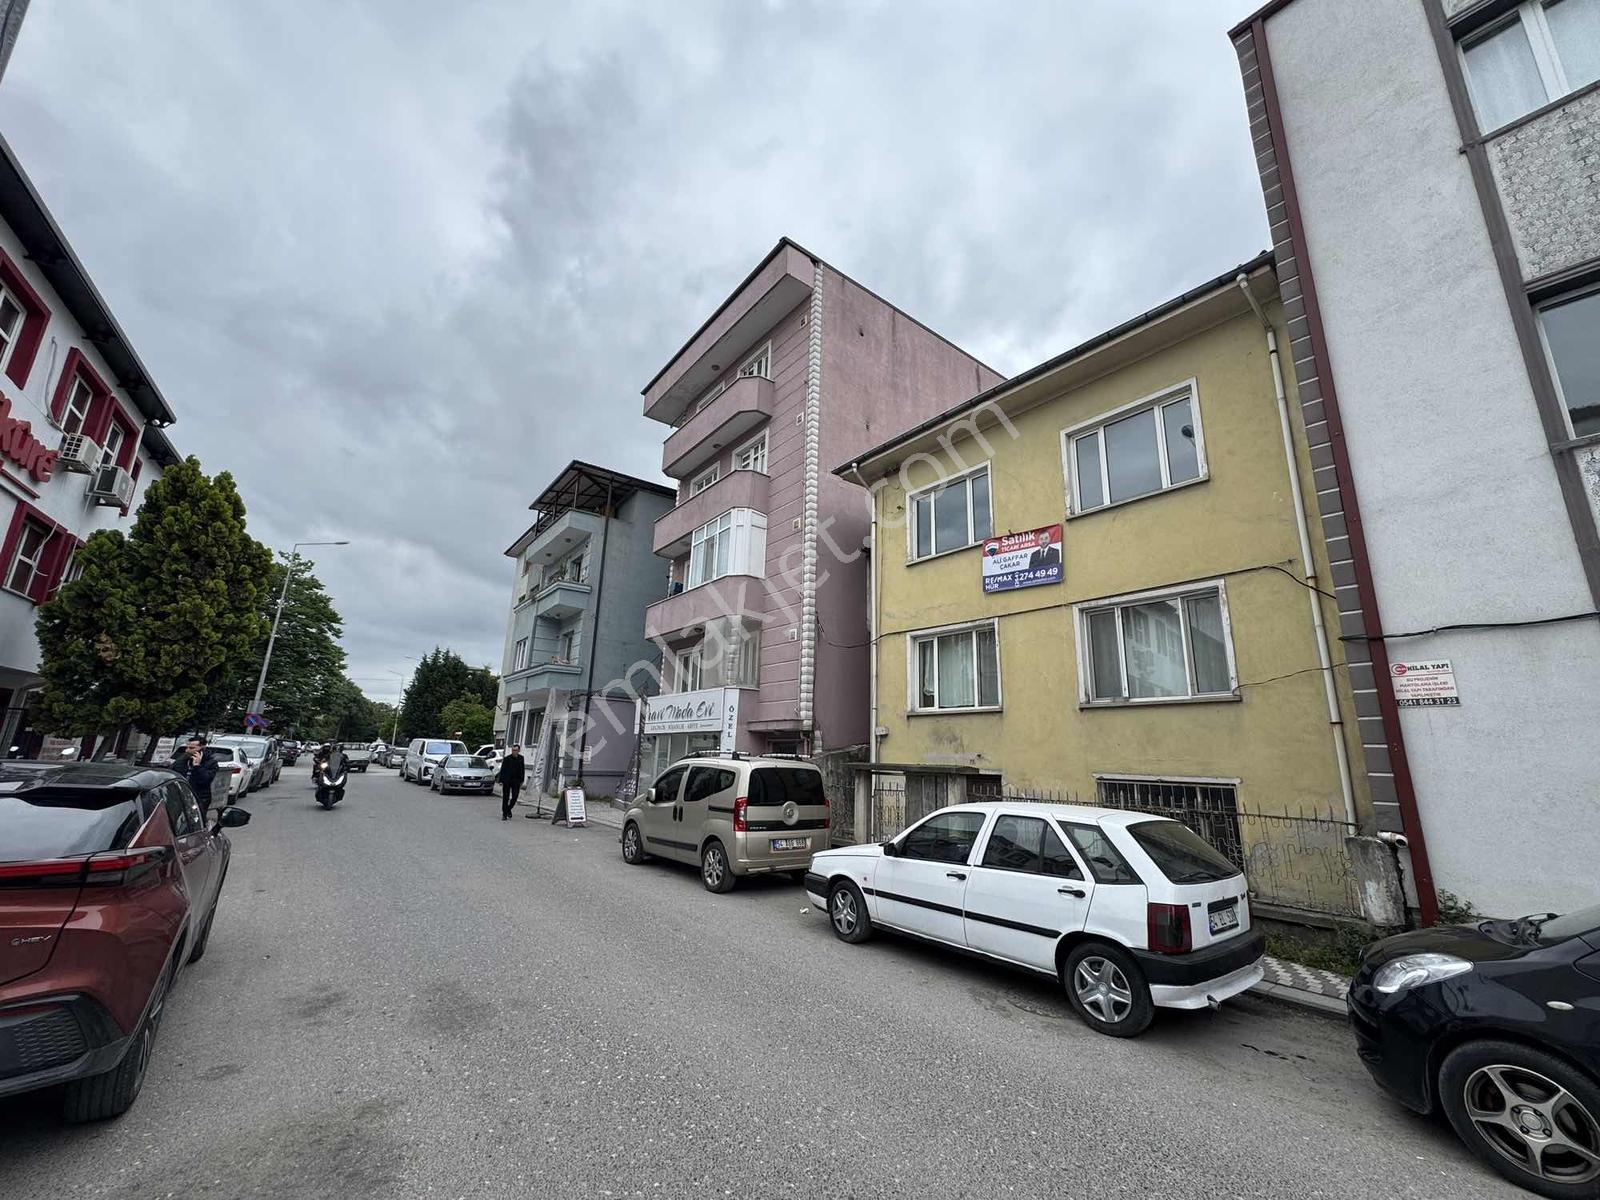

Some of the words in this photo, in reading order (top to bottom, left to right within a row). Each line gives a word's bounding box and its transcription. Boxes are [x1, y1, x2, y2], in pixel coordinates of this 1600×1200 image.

[1002, 532, 1035, 546] Satılık
[985, 574, 1013, 585] RE/MAX
[1019, 571, 1034, 581] 274
[1035, 569, 1046, 579] 49
[1047, 567, 1059, 577] 49
